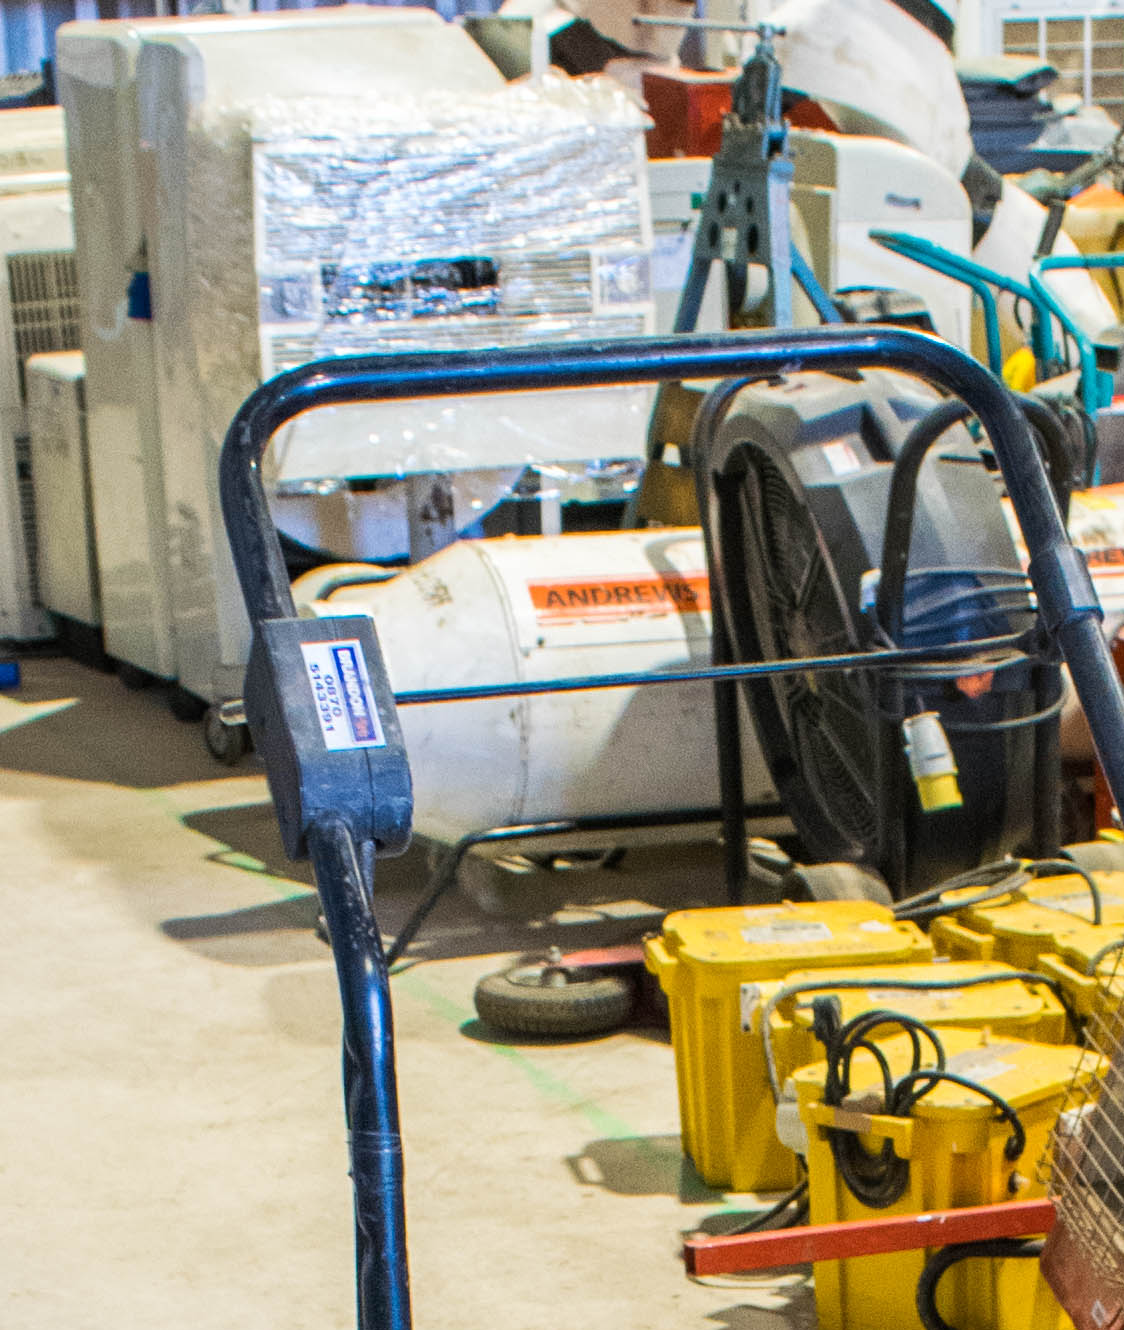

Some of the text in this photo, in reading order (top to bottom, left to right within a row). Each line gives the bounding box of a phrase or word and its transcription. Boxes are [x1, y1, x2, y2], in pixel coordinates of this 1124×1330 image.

[546, 583, 698, 608] ANDREWS
[310, 663, 335, 731] 5143391
[324, 674, 342, 717] 0870
